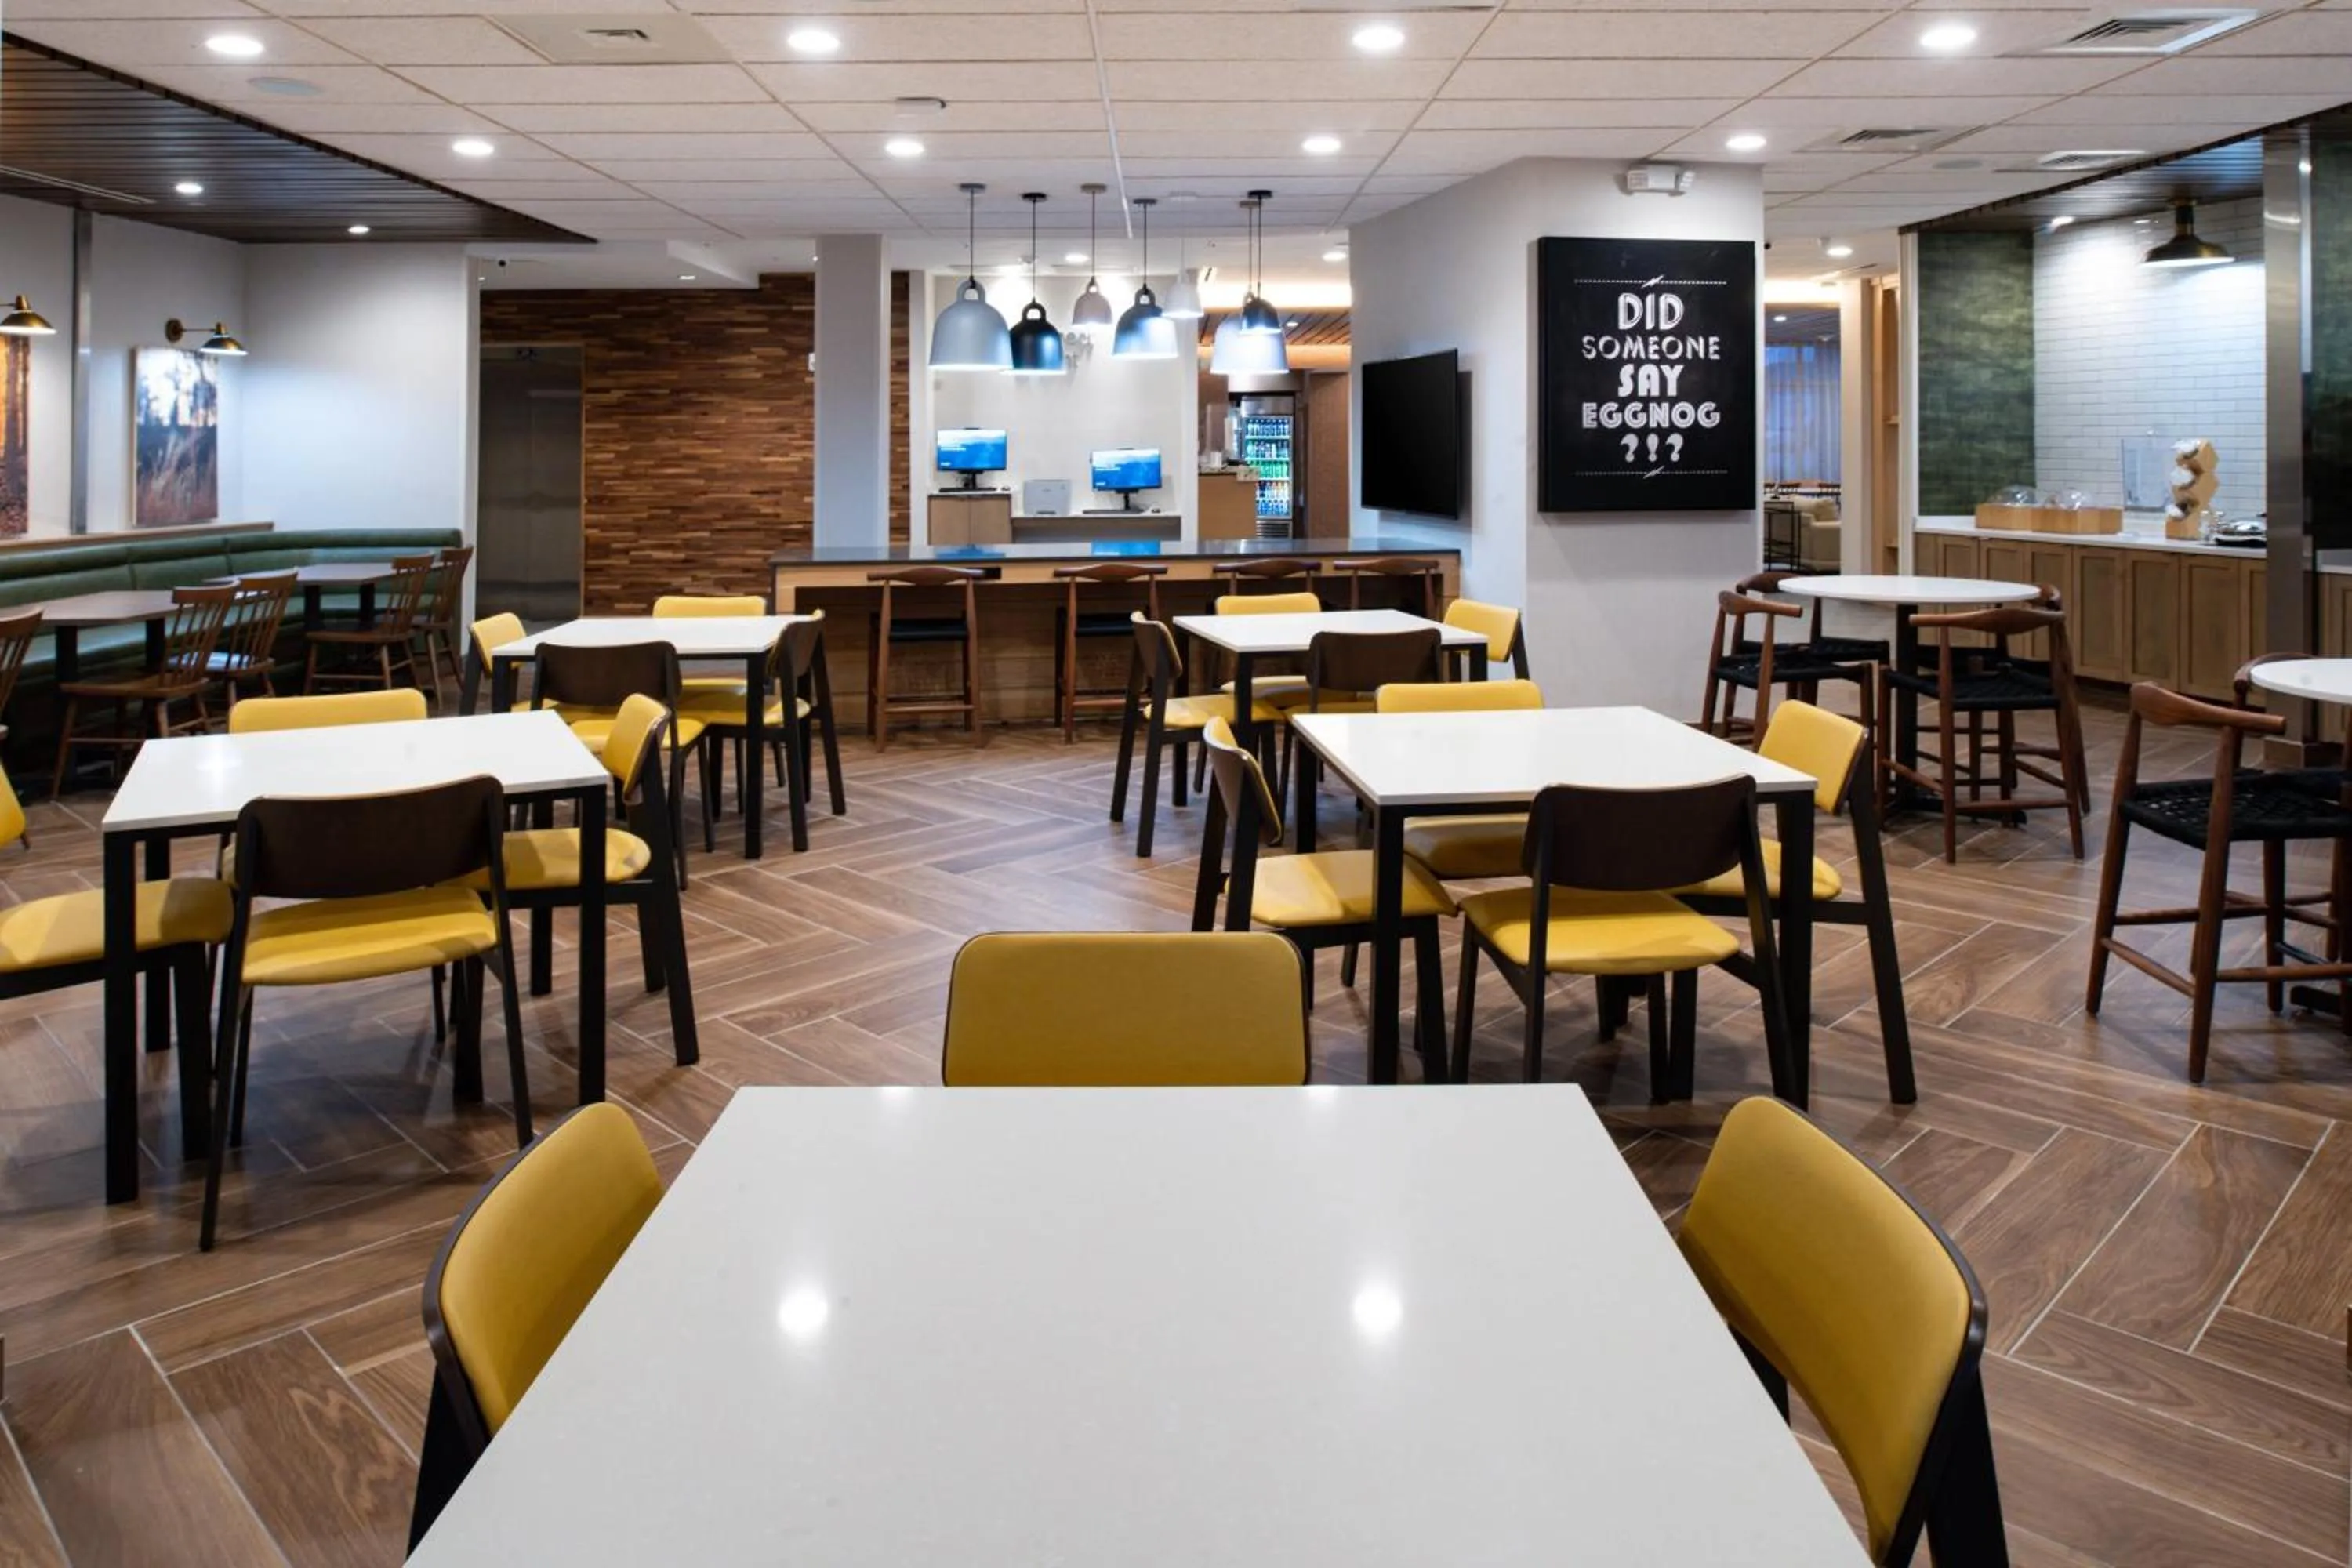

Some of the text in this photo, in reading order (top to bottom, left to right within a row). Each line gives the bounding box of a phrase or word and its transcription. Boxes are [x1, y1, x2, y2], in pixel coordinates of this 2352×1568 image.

[1618, 292, 1684, 331] DID
[1582, 335, 1720, 360] SOMEONE
[1618, 363, 1684, 397] SAY
[1582, 401, 1720, 428] EGGNOG
